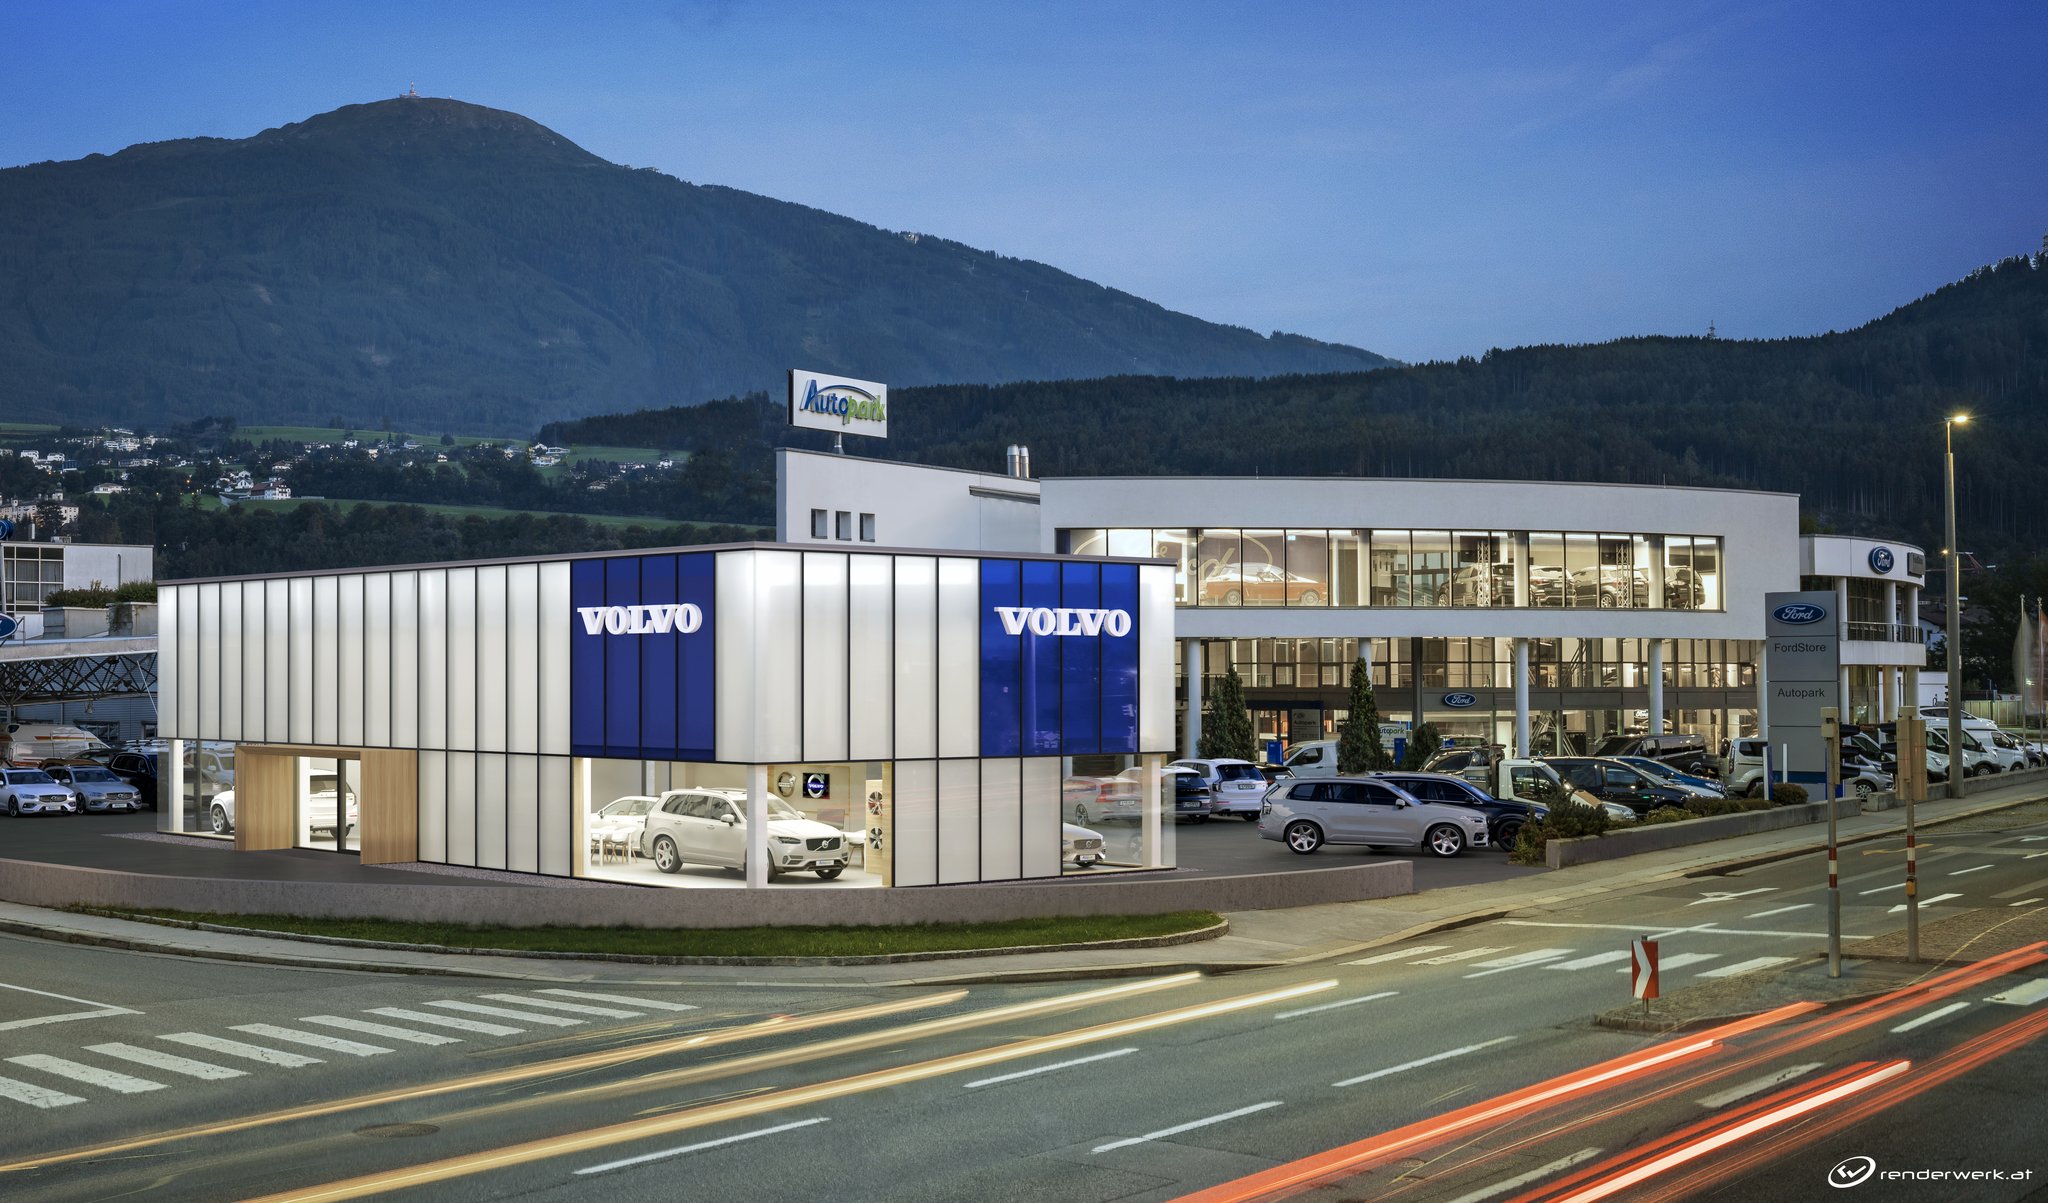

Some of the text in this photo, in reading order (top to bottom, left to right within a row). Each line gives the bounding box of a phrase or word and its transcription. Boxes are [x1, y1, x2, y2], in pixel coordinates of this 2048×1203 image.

[799, 379, 887, 425] Autopark
[577, 603, 703, 635] VOLVO
[1782, 607, 1814, 620] Ford
[994, 607, 1131, 637] VOLVO
[1775, 643, 1827, 653] FordStore
[1451, 694, 1471, 704] Ford
[1778, 688, 1826, 699] Autopark
